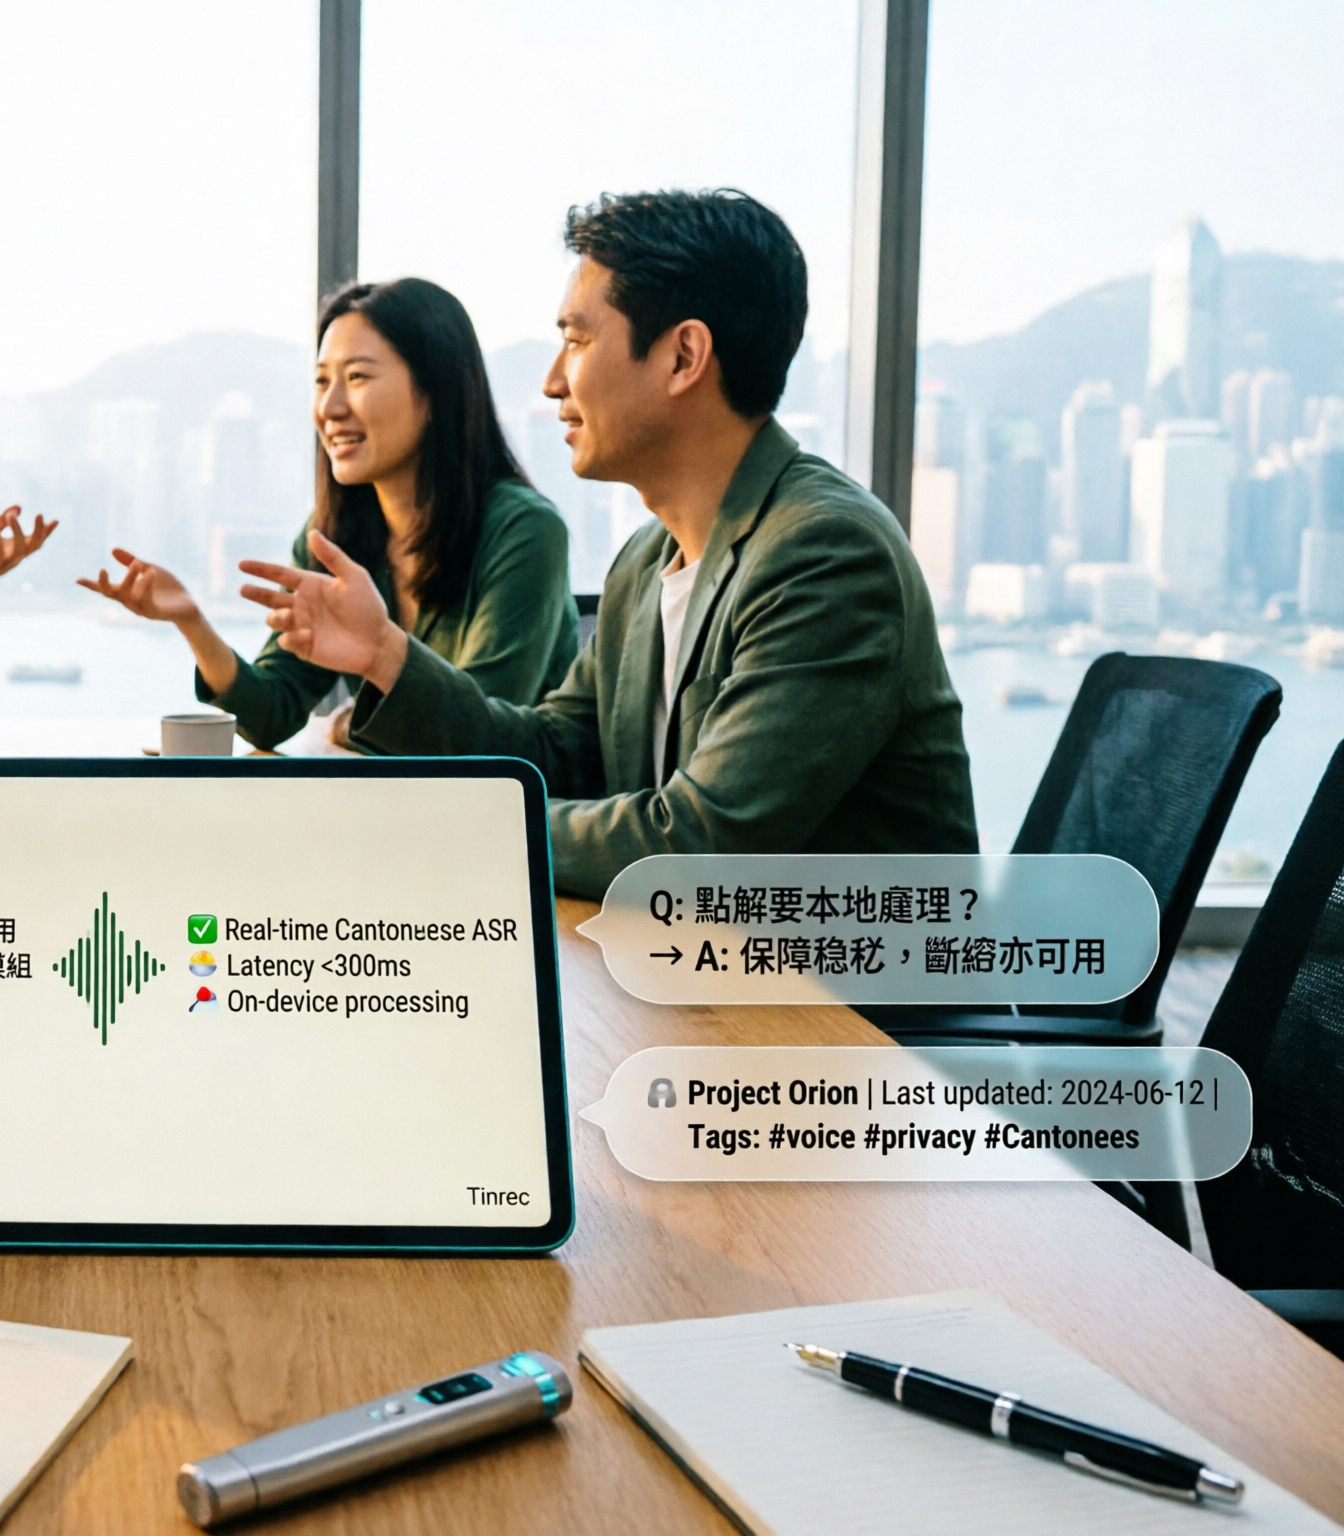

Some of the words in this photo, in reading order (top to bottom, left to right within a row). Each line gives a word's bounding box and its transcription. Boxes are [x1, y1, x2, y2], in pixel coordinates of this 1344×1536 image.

[225, 917, 328, 941] Real-time
[472, 918, 518, 942] ASR
[227, 953, 315, 983] Latency
[321, 953, 411, 977] <300ms
[228, 988, 338, 1013] On-device
[345, 989, 469, 1019] processing
[466, 1186, 530, 1206] Tinrec
